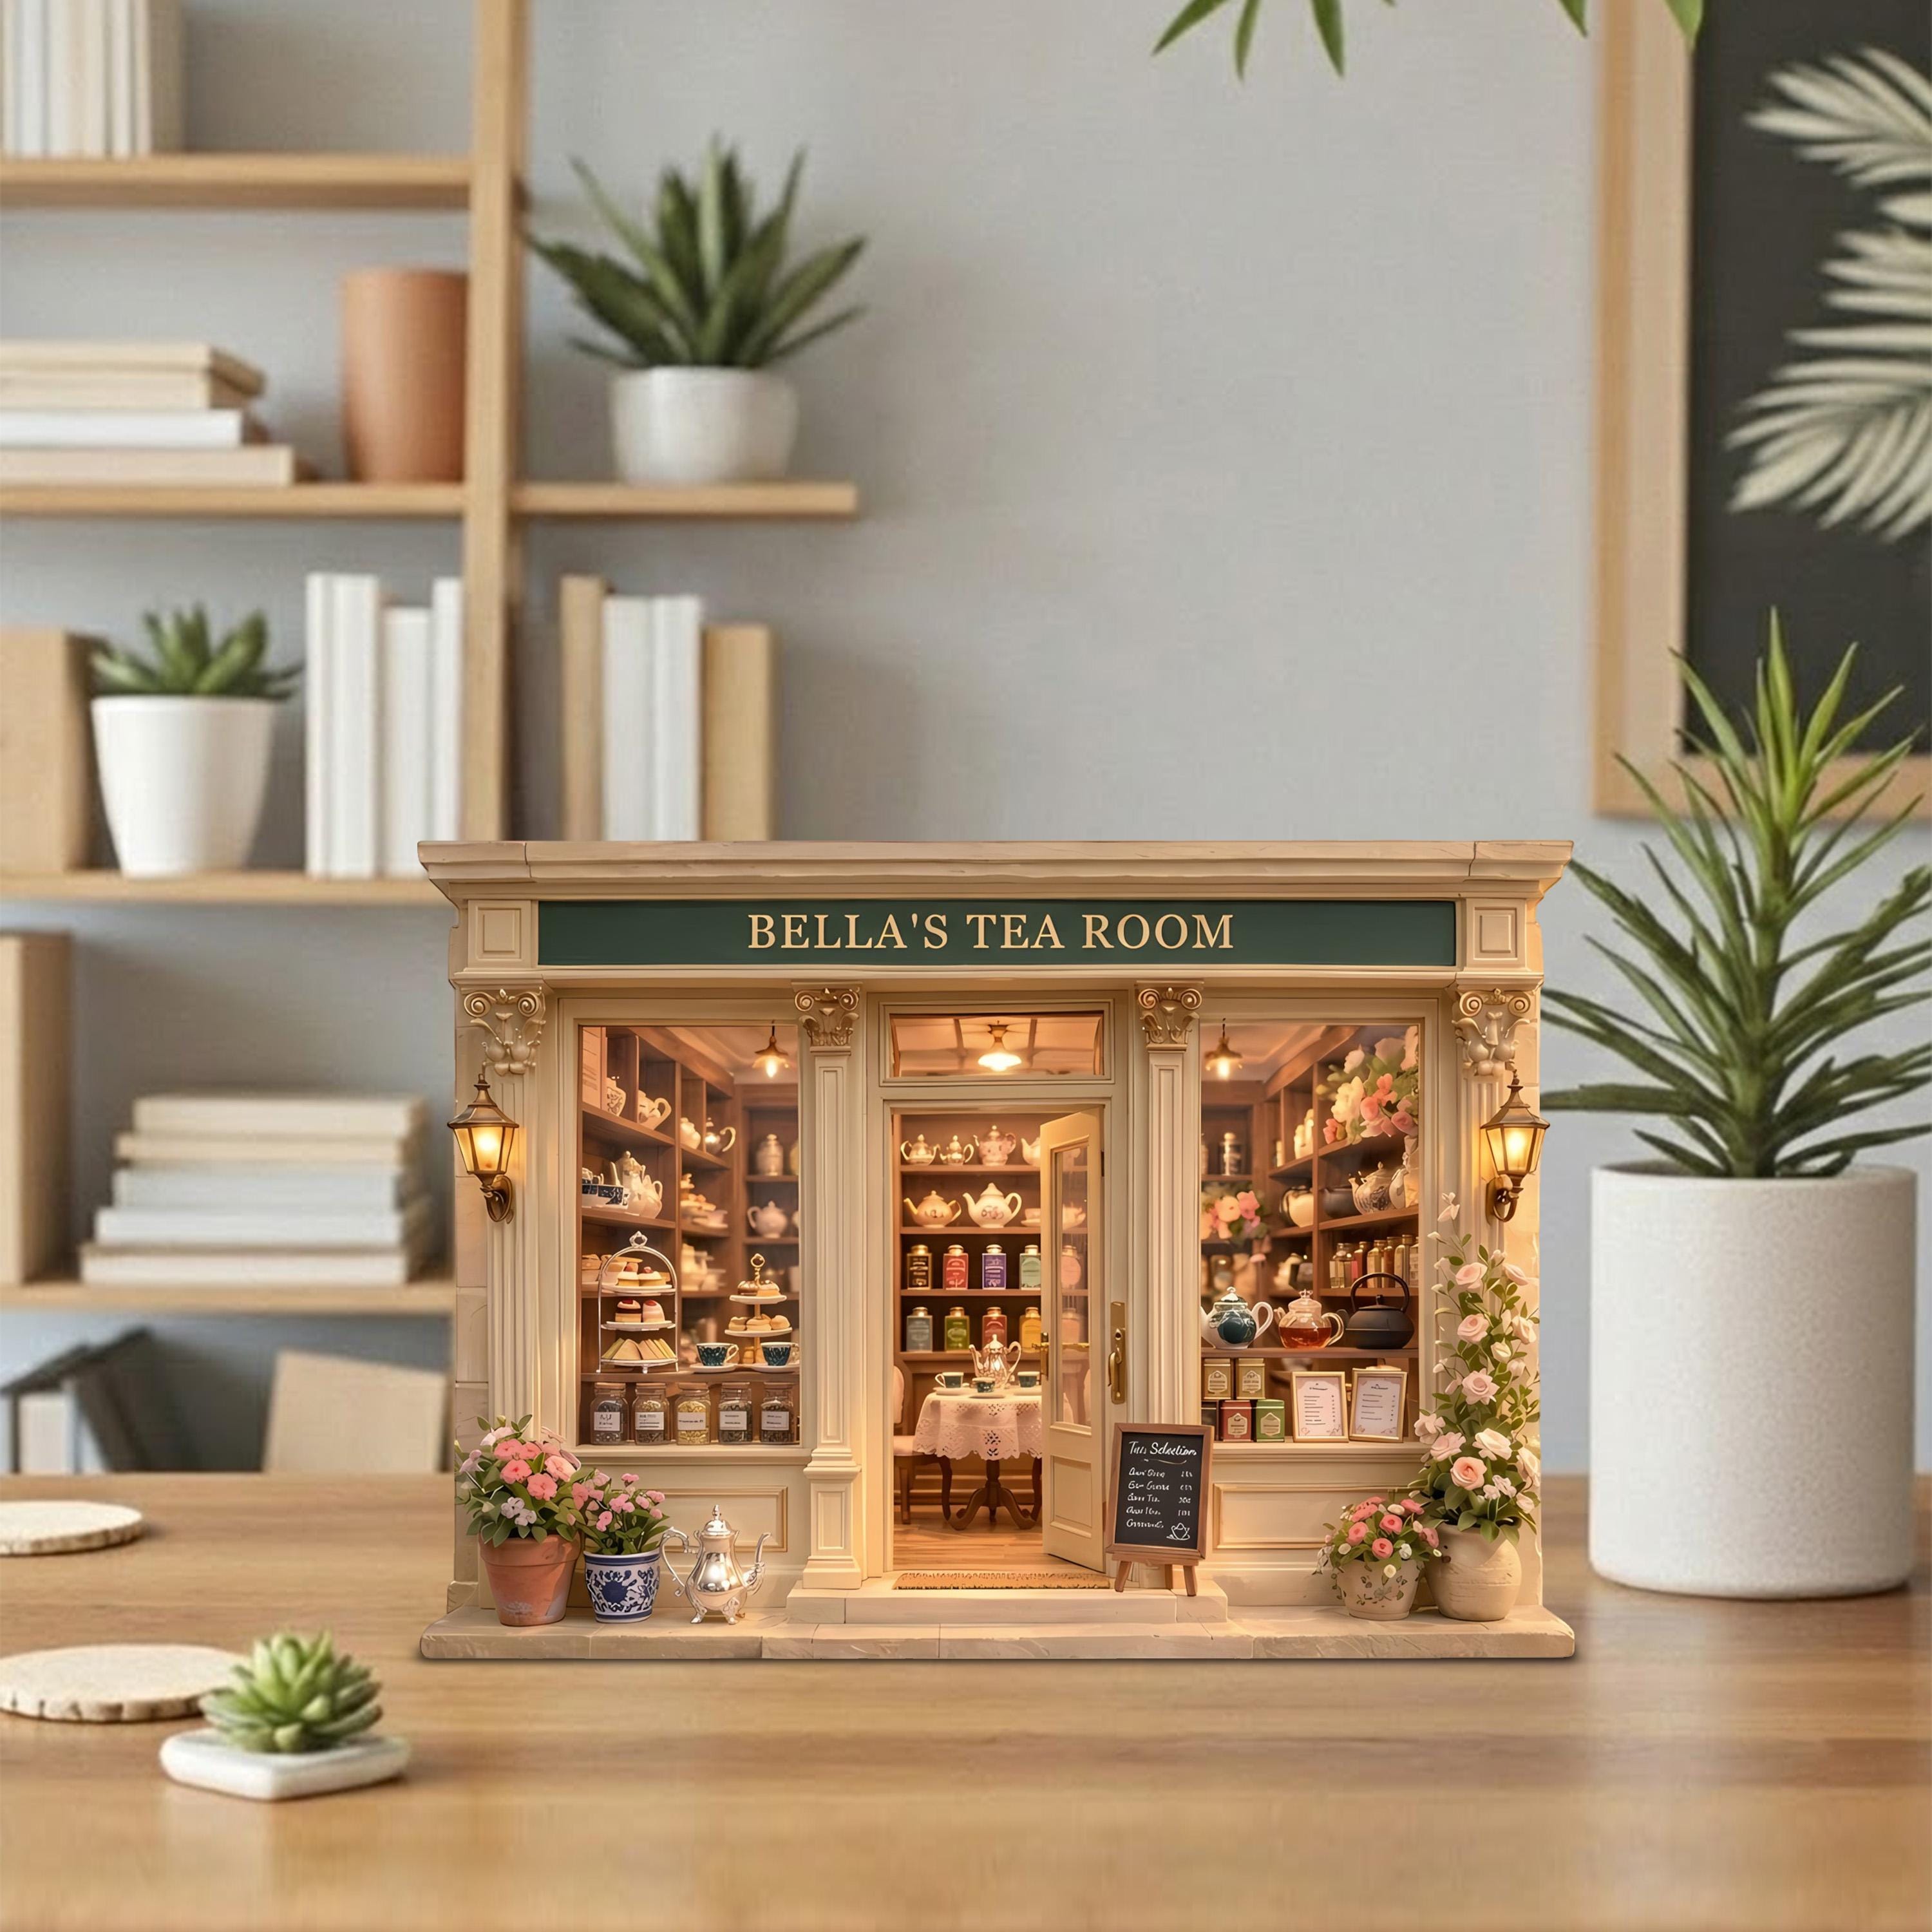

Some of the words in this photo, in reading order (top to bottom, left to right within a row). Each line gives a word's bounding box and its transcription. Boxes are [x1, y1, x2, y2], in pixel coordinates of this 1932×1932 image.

[748, 913, 948, 949] BELLA'S
[966, 913, 1065, 949] TEA
[1081, 913, 1234, 949] ROOM
